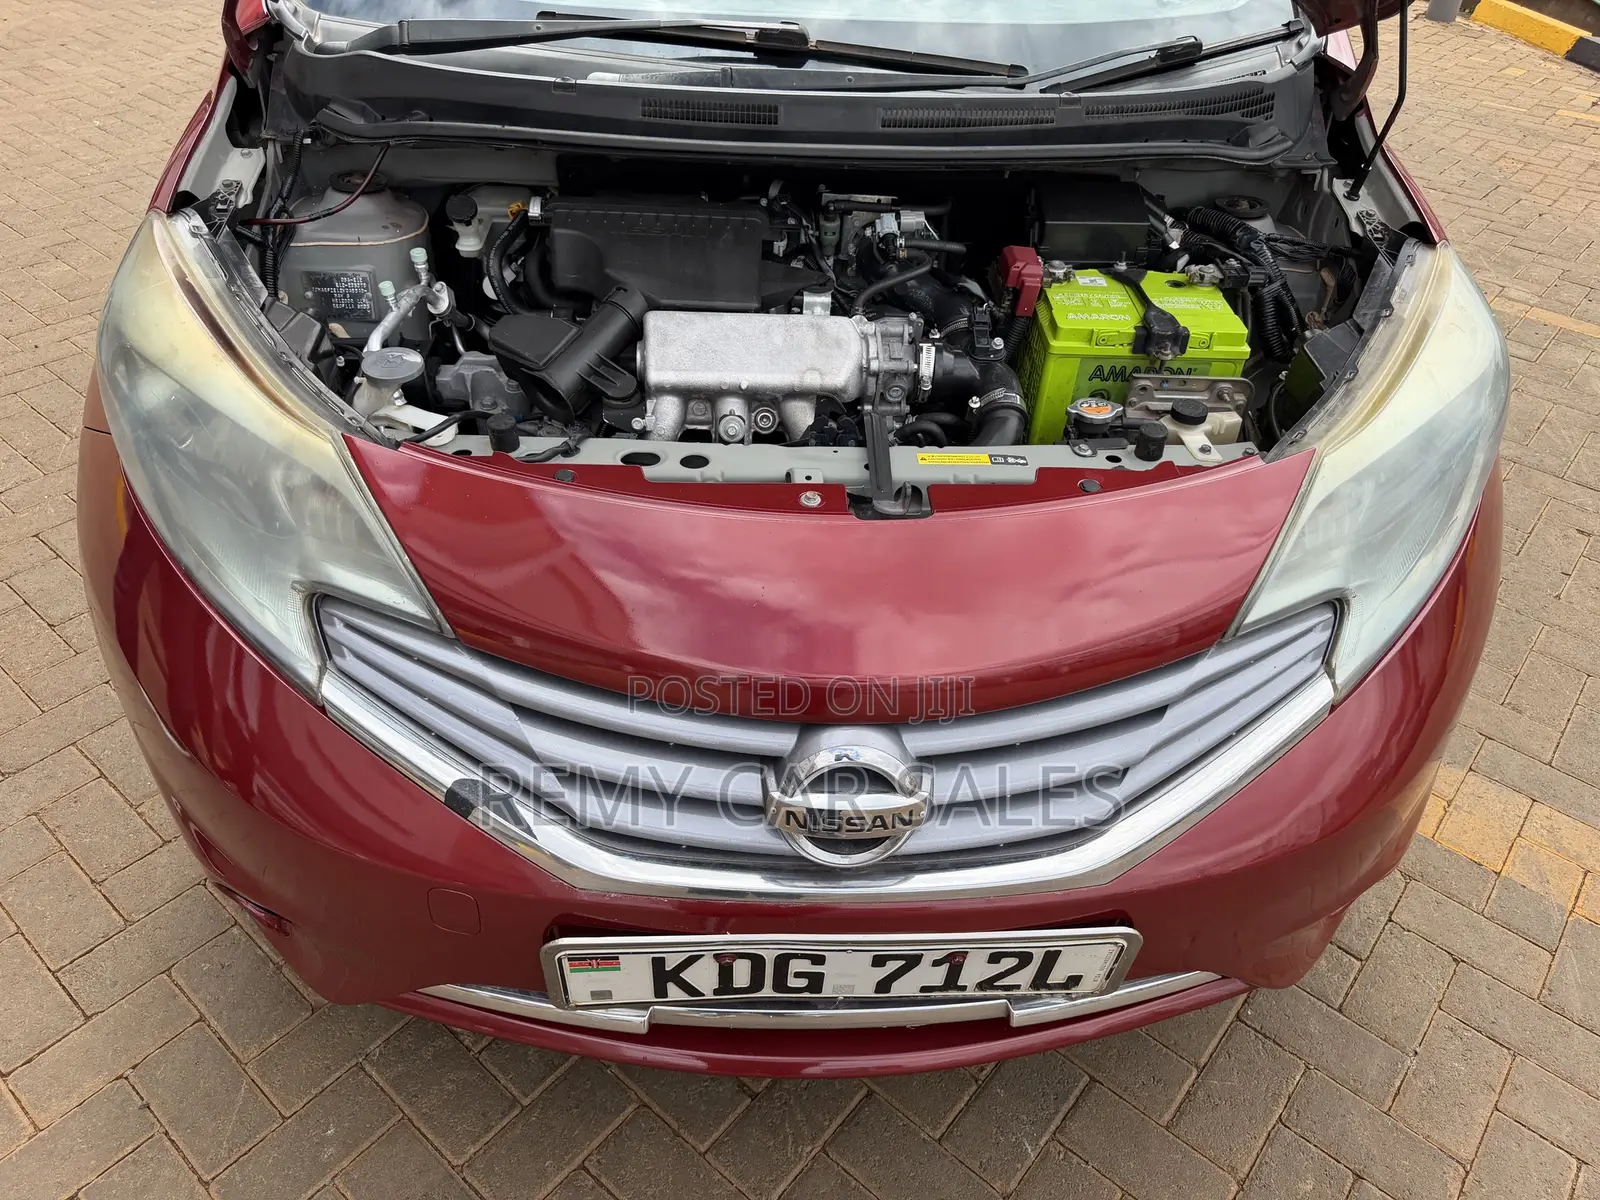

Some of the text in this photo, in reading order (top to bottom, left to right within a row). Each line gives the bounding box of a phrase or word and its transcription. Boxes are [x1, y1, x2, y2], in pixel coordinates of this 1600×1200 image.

[1067, 312, 1131, 321] AMARON
[784, 808, 915, 833] NISSAN
[652, 952, 827, 999] KDG
[870, 949, 1085, 995] 712L
